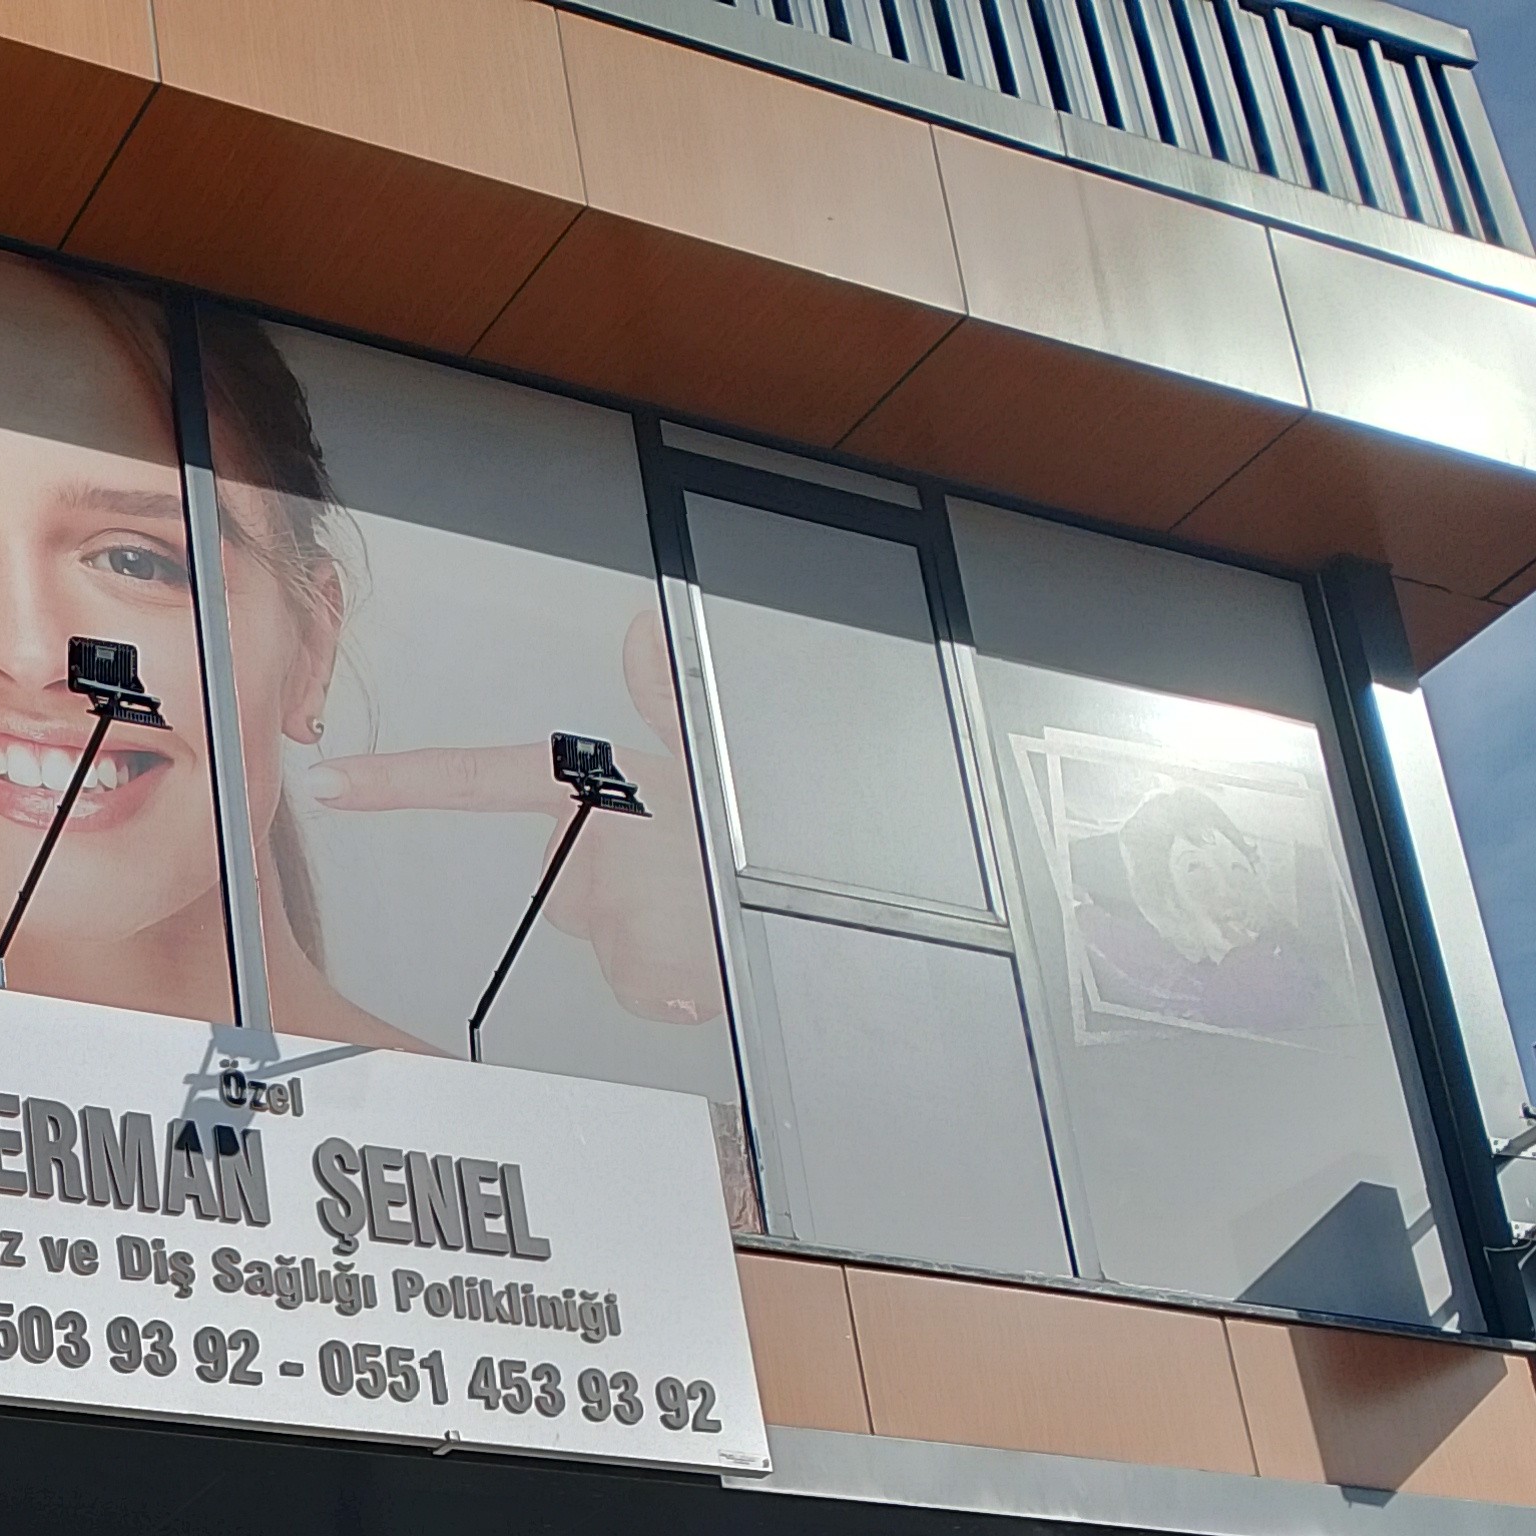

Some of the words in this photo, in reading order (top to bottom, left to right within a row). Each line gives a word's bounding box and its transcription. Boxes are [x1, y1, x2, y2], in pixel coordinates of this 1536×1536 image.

[219, 1059, 304, 1117] Özel
[312, 1137, 552, 1262] ŞENEL
[39, 1235, 99, 1276] ve
[116, 1234, 197, 1300] Diş
[211, 1246, 378, 1318] Sağlığı
[392, 1268, 622, 1344] Polikliniği
[106, 1316, 177, 1378] 93
[194, 1326, 263, 1387] 92
[279, 1360, 305, 1378] -
[318, 1340, 449, 1405] 0551
[467, 1356, 567, 1418] 453
[577, 1367, 645, 1426] 93
[655, 1376, 723, 1434] 92
